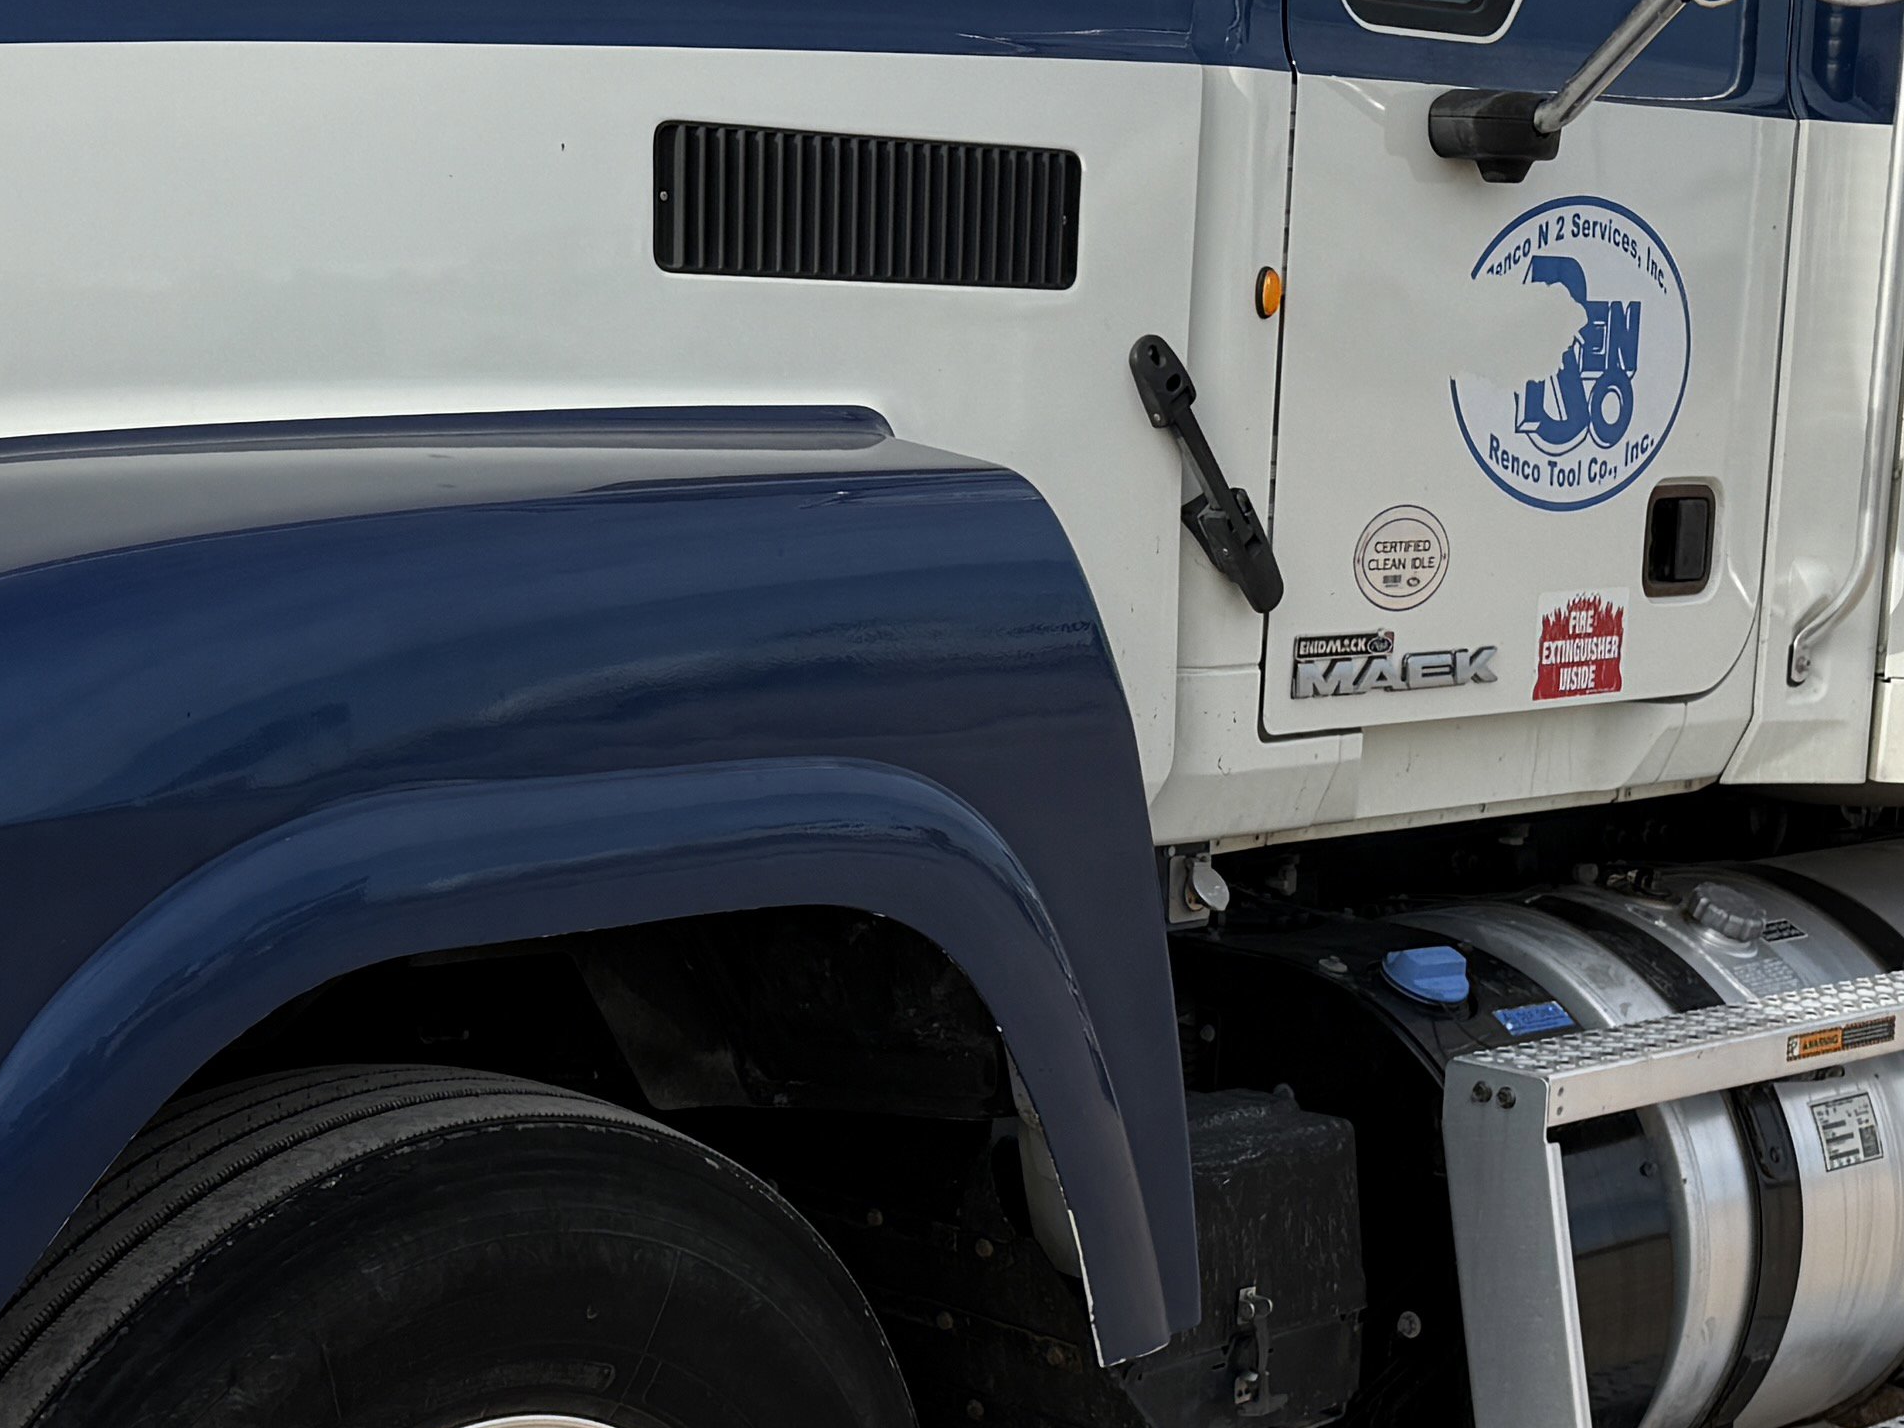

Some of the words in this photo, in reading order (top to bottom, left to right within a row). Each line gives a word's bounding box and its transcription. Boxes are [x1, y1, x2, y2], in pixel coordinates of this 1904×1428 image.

[1538, 221, 1549, 249] N
[1555, 215, 1565, 241] 2
[1571, 213, 1641, 269] Services,
[1646, 246, 1667, 294] Inc.
[1489, 433, 1541, 483] Renco
[1548, 460, 1581, 487] Tool
[1624, 433, 1654, 467] Inc.
[1374, 539, 1431, 554] CERTIFIED
[1368, 558, 1406, 570] CLEAN
[1411, 556, 1435, 569] IDLE
[1569, 609, 1594, 634] FIRE
[1542, 635, 1619, 664] EXTINGUISHER
[1292, 646, 1497, 699] MACK
